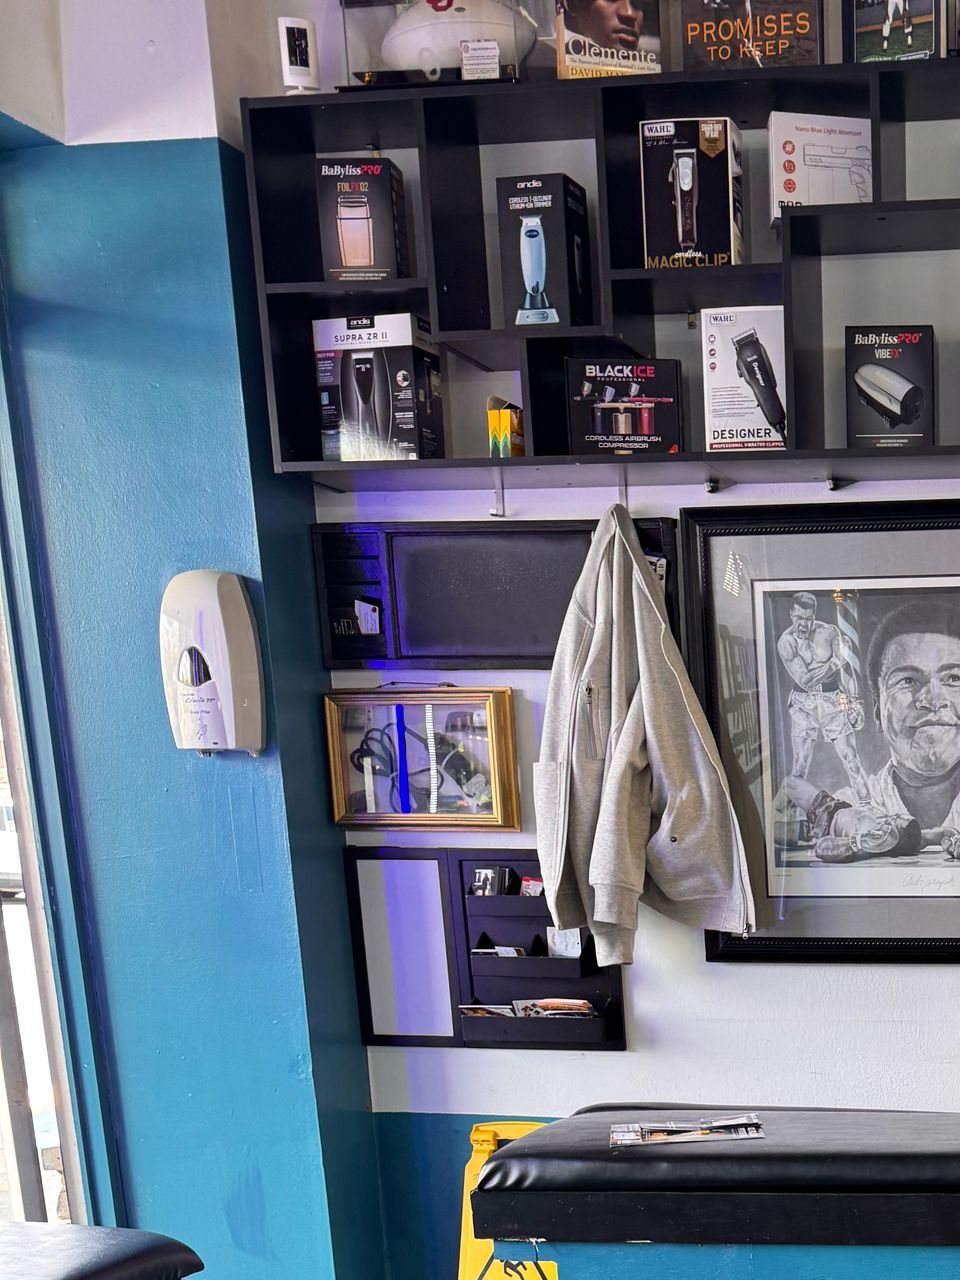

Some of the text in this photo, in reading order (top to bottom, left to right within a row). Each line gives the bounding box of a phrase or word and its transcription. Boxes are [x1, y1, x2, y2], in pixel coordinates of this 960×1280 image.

[687, 12, 810, 45] PROMISES
[568, 37, 657, 65] Clemente
[707, 40, 789, 61] TO KEEP
[571, 67, 602, 78] DAVID
[646, 125, 673, 134] WAHL
[516, 180, 542, 189] andis
[674, 249, 702, 258] cordless
[647, 253, 728, 269] MAGIC CLIP
[712, 314, 734, 322] WAHL
[333, 333, 364, 343] SUPRA
[366, 332, 379, 340] ZR
[712, 428, 772, 440] DESIGNER
